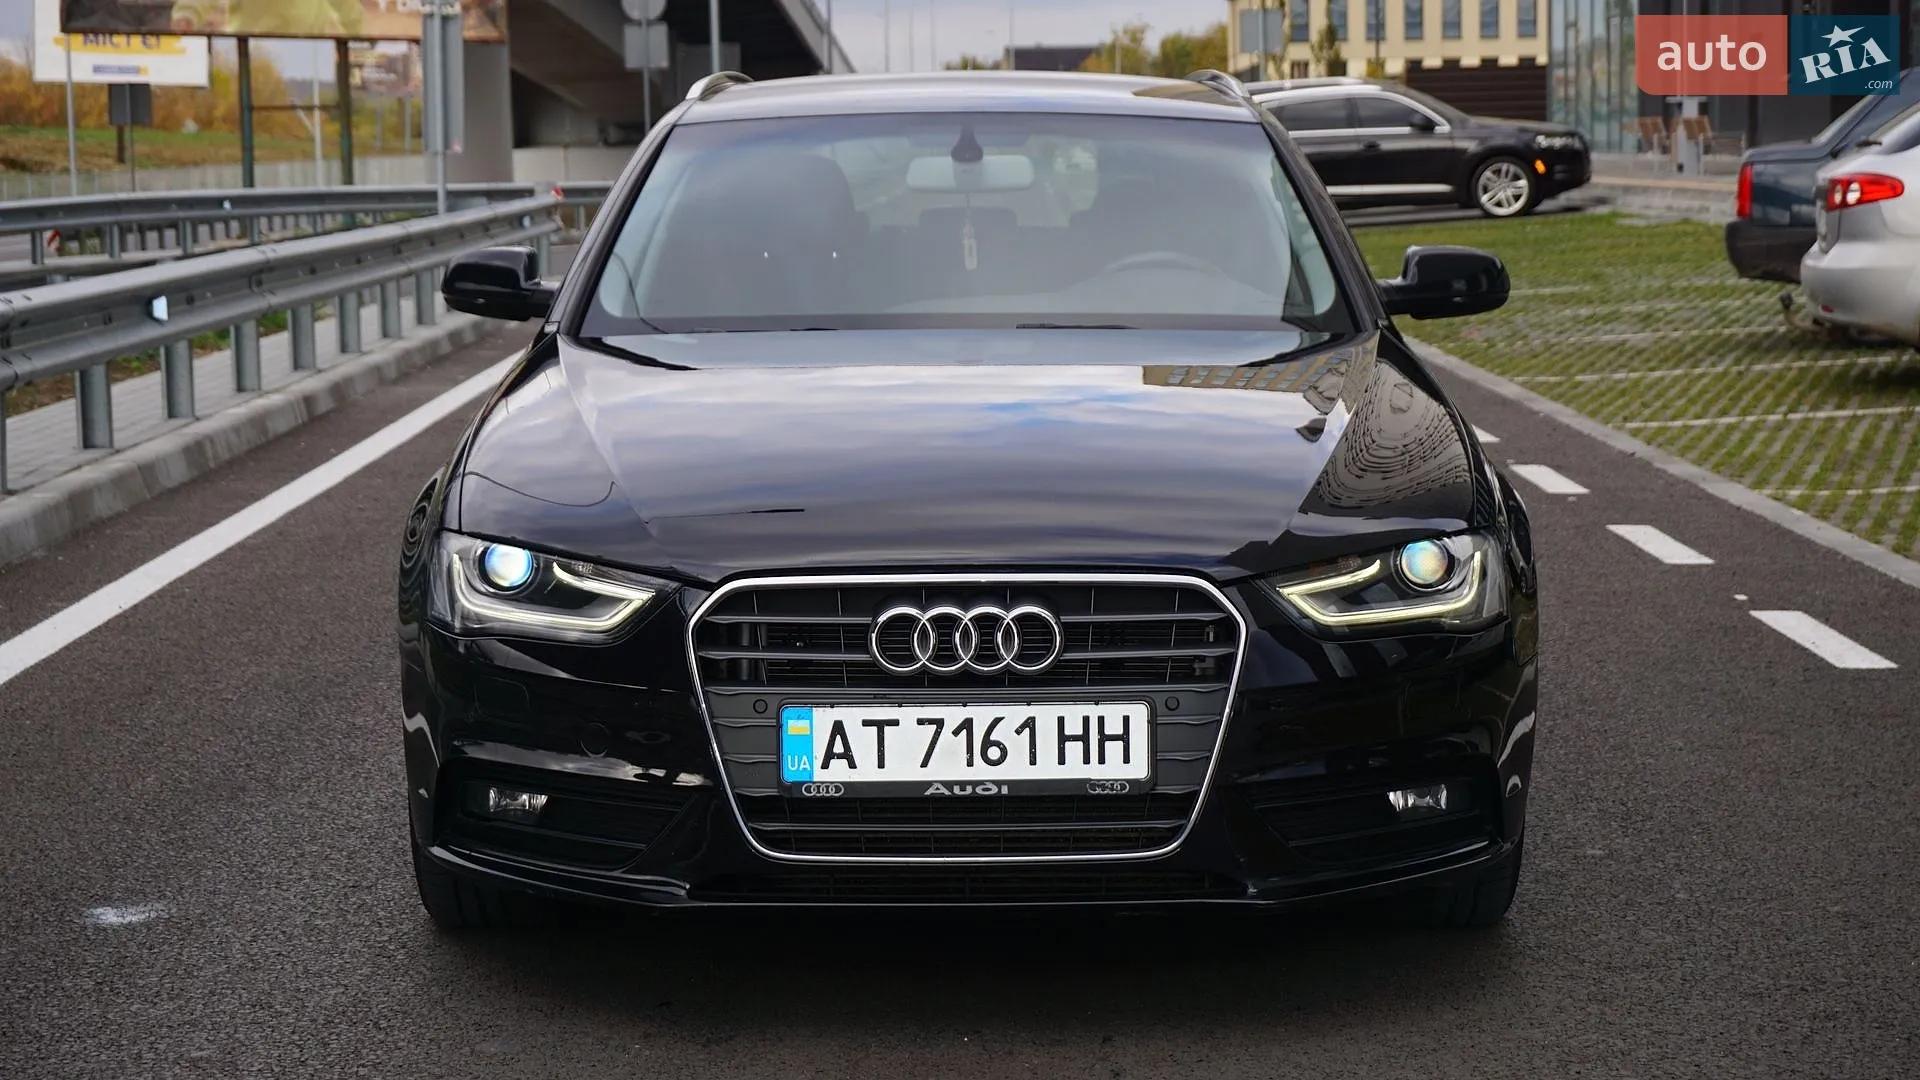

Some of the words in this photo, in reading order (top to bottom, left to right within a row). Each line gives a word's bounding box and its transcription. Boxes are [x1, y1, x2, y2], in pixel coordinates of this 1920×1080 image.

[820, 718, 899, 769] AT
[916, 716, 1036, 767] 7161
[1057, 715, 1131, 765] HH
[787, 755, 811, 771] UA
[923, 781, 1009, 796] Audi
